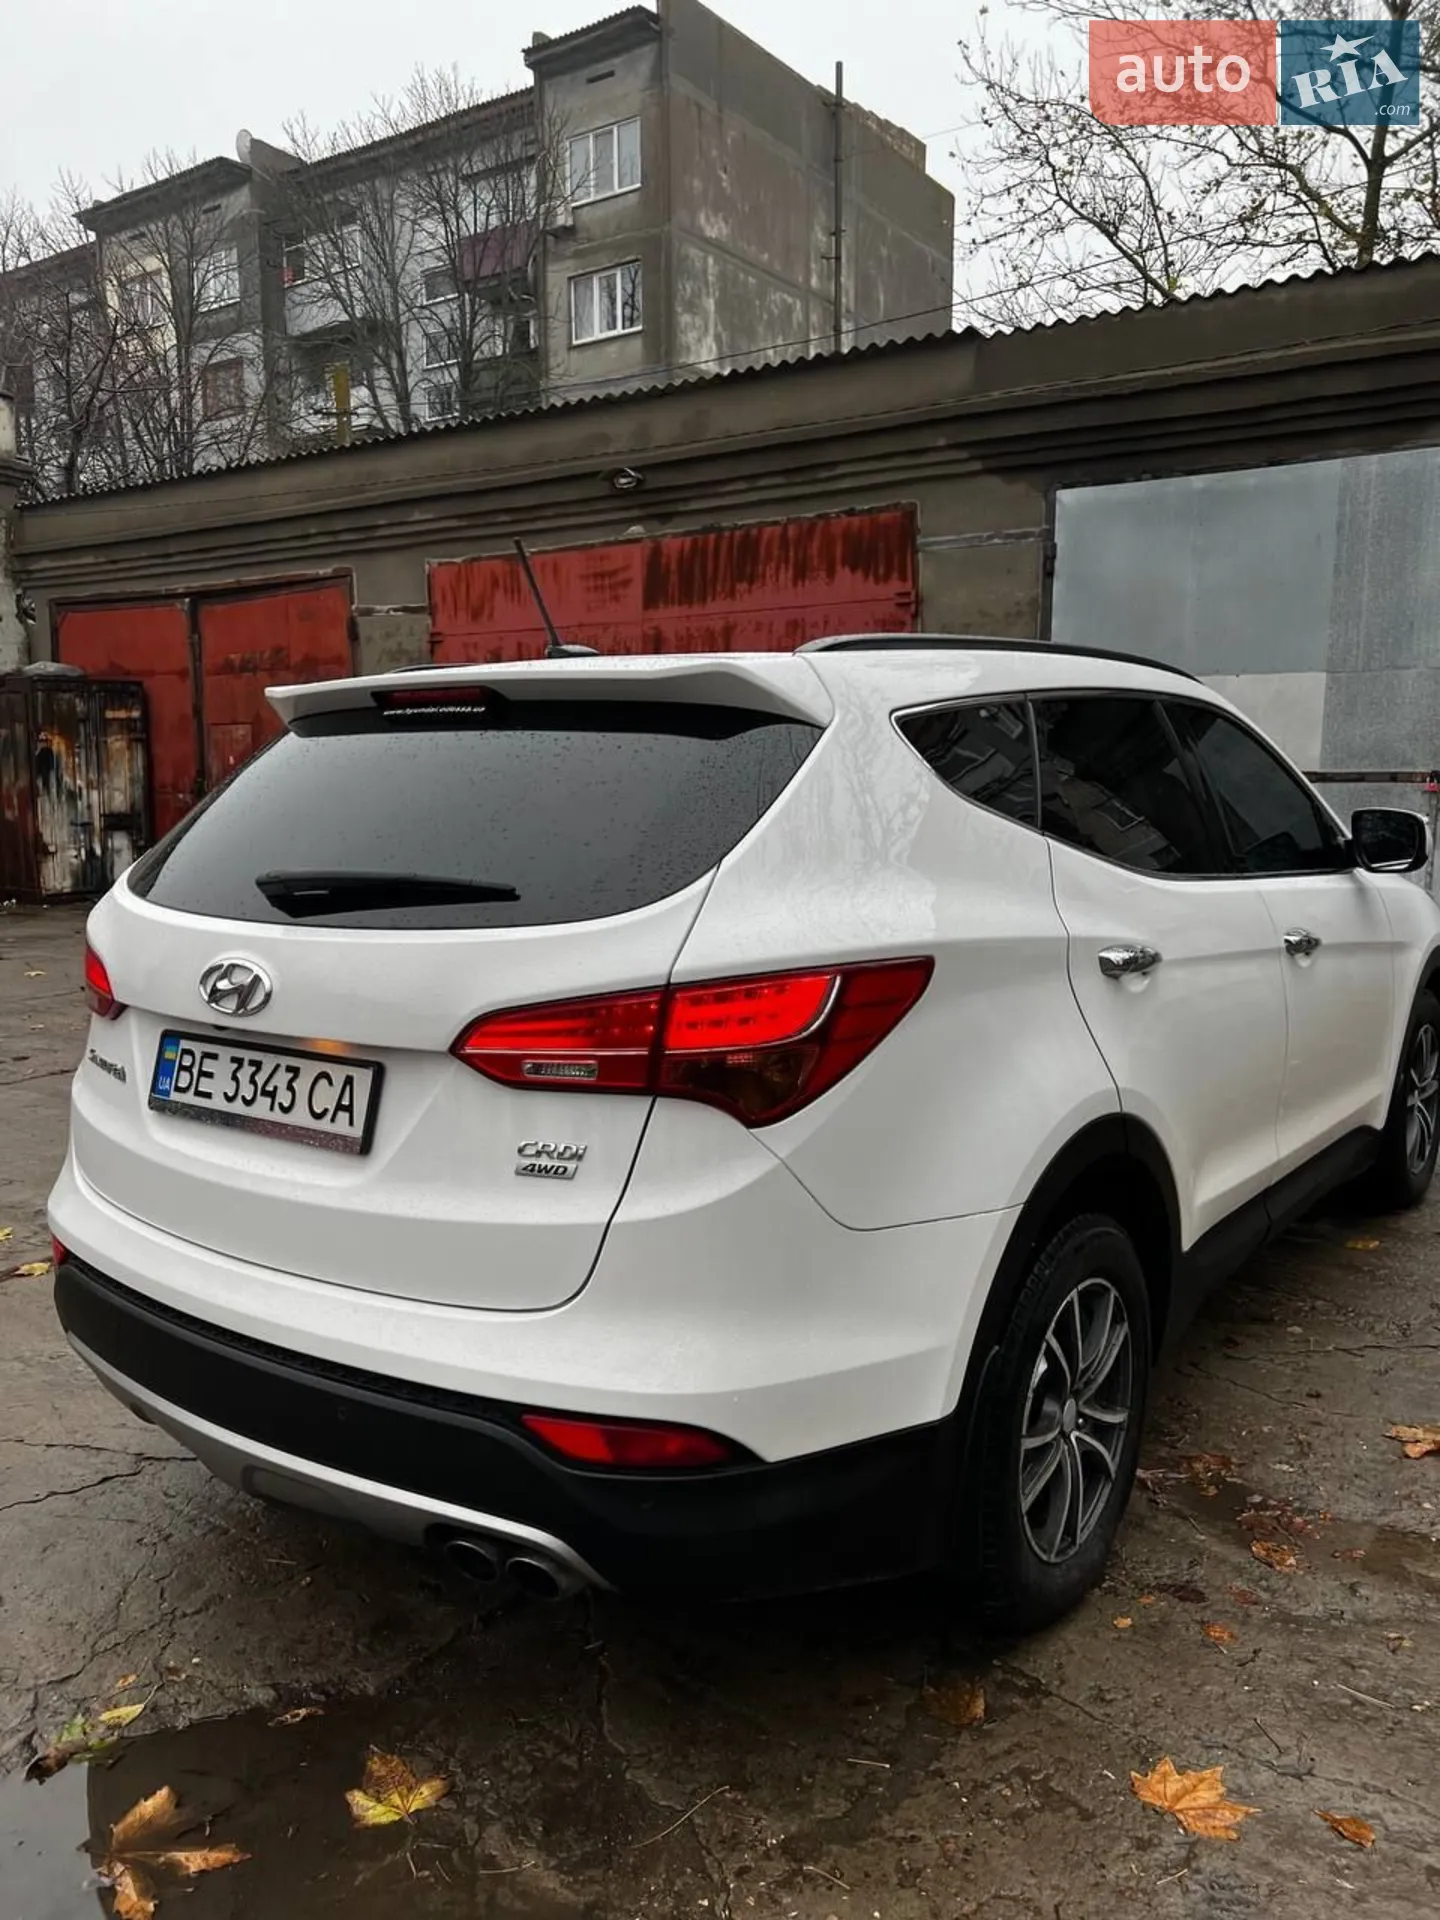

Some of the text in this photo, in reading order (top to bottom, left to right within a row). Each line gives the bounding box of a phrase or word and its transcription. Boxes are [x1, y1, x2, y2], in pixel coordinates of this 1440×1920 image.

[158, 1075, 171, 1091] UA
[173, 1048, 219, 1099] BE
[223, 1055, 301, 1114] 3343
[307, 1069, 355, 1127] CA
[521, 1163, 569, 1176] 4WD
